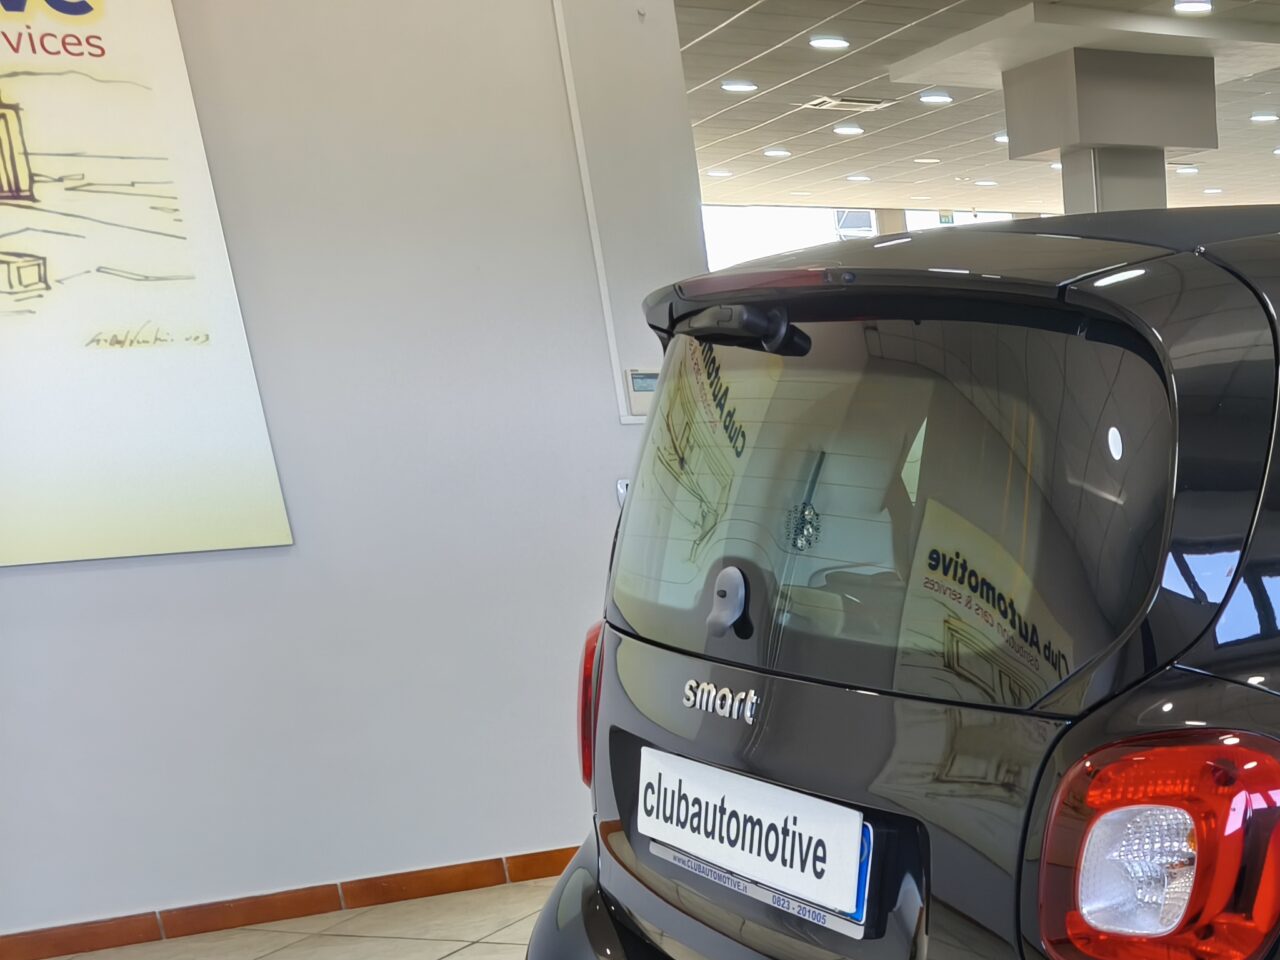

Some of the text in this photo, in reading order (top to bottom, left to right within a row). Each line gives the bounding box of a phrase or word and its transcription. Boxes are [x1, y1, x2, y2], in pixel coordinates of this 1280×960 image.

[0, 24, 106, 58] vices
[682, 679, 758, 725] smart
[643, 772, 828, 880] clubautomotive
[772, 894, 791, 911] 0823
[797, 907, 827, 925] 201005
